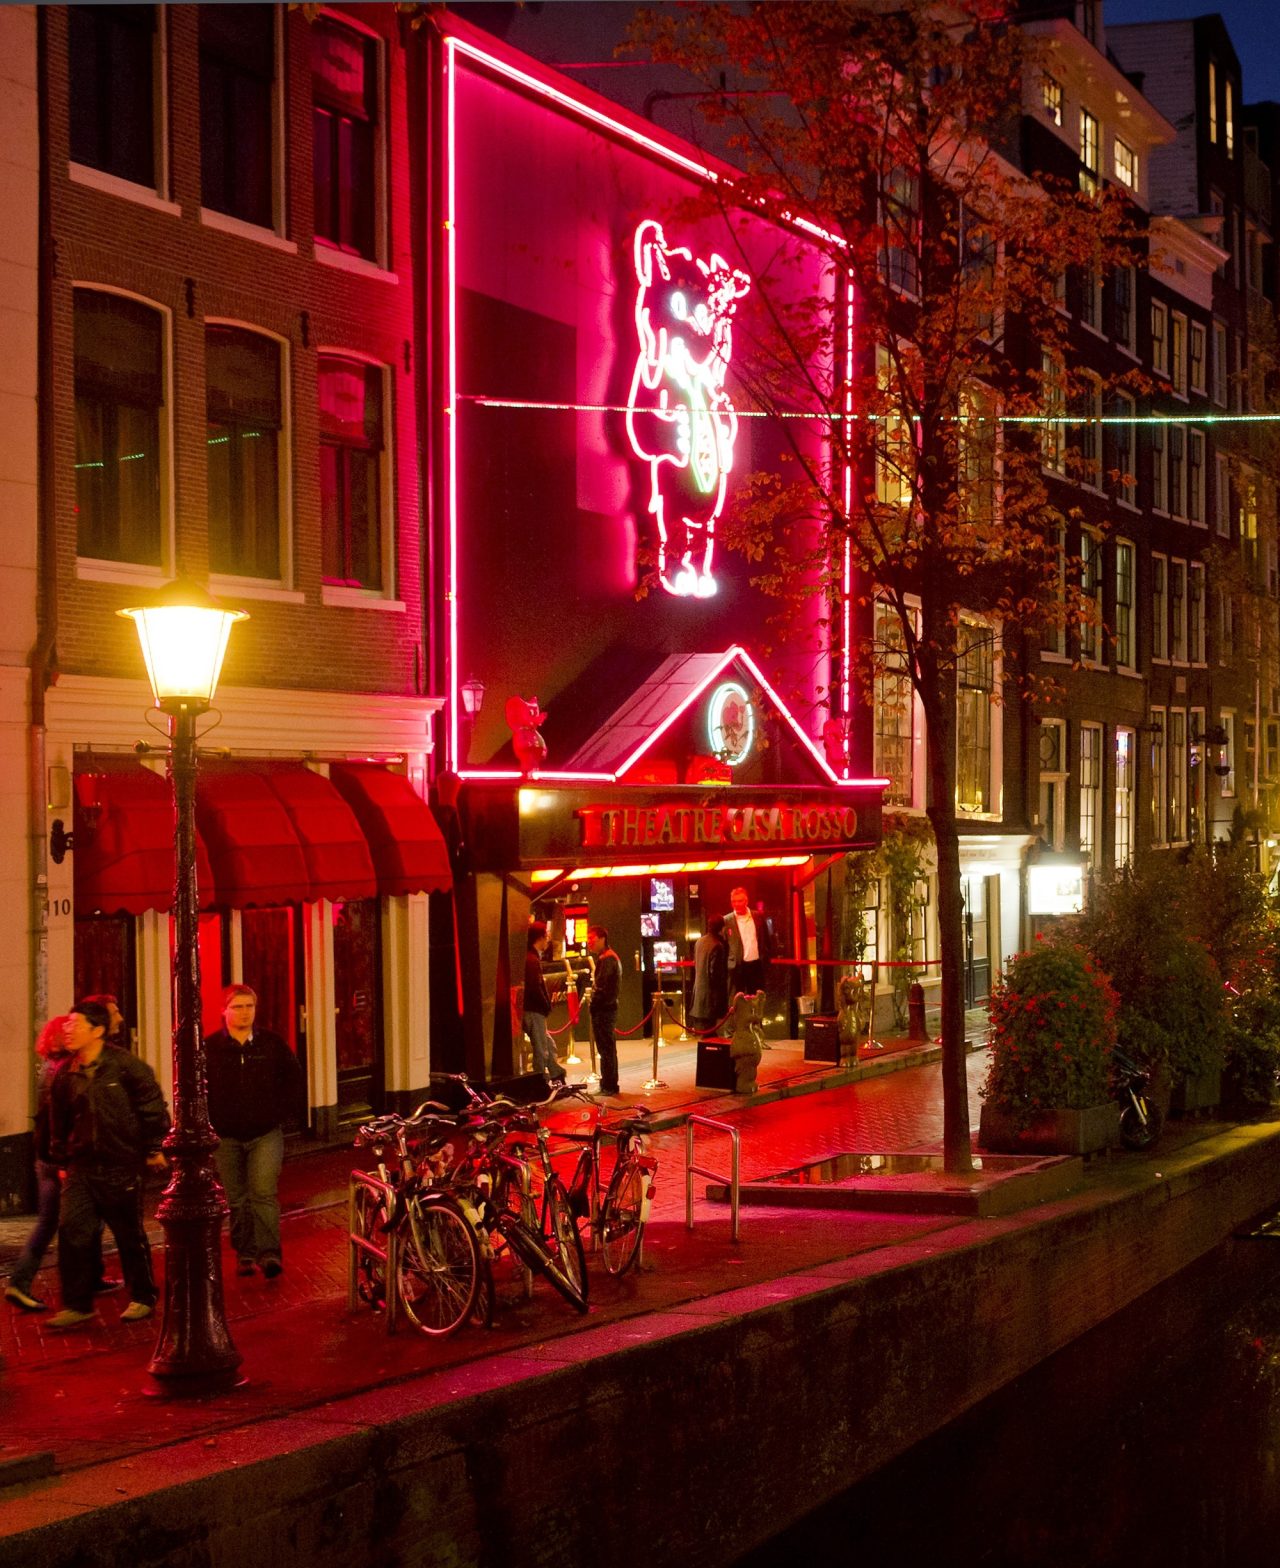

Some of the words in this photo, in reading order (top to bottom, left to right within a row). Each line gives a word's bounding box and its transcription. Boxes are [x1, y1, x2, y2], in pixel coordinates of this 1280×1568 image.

[602, 807, 722, 847] THEATRE
[729, 806, 785, 842] CASA
[792, 806, 858, 840] ROSSO
